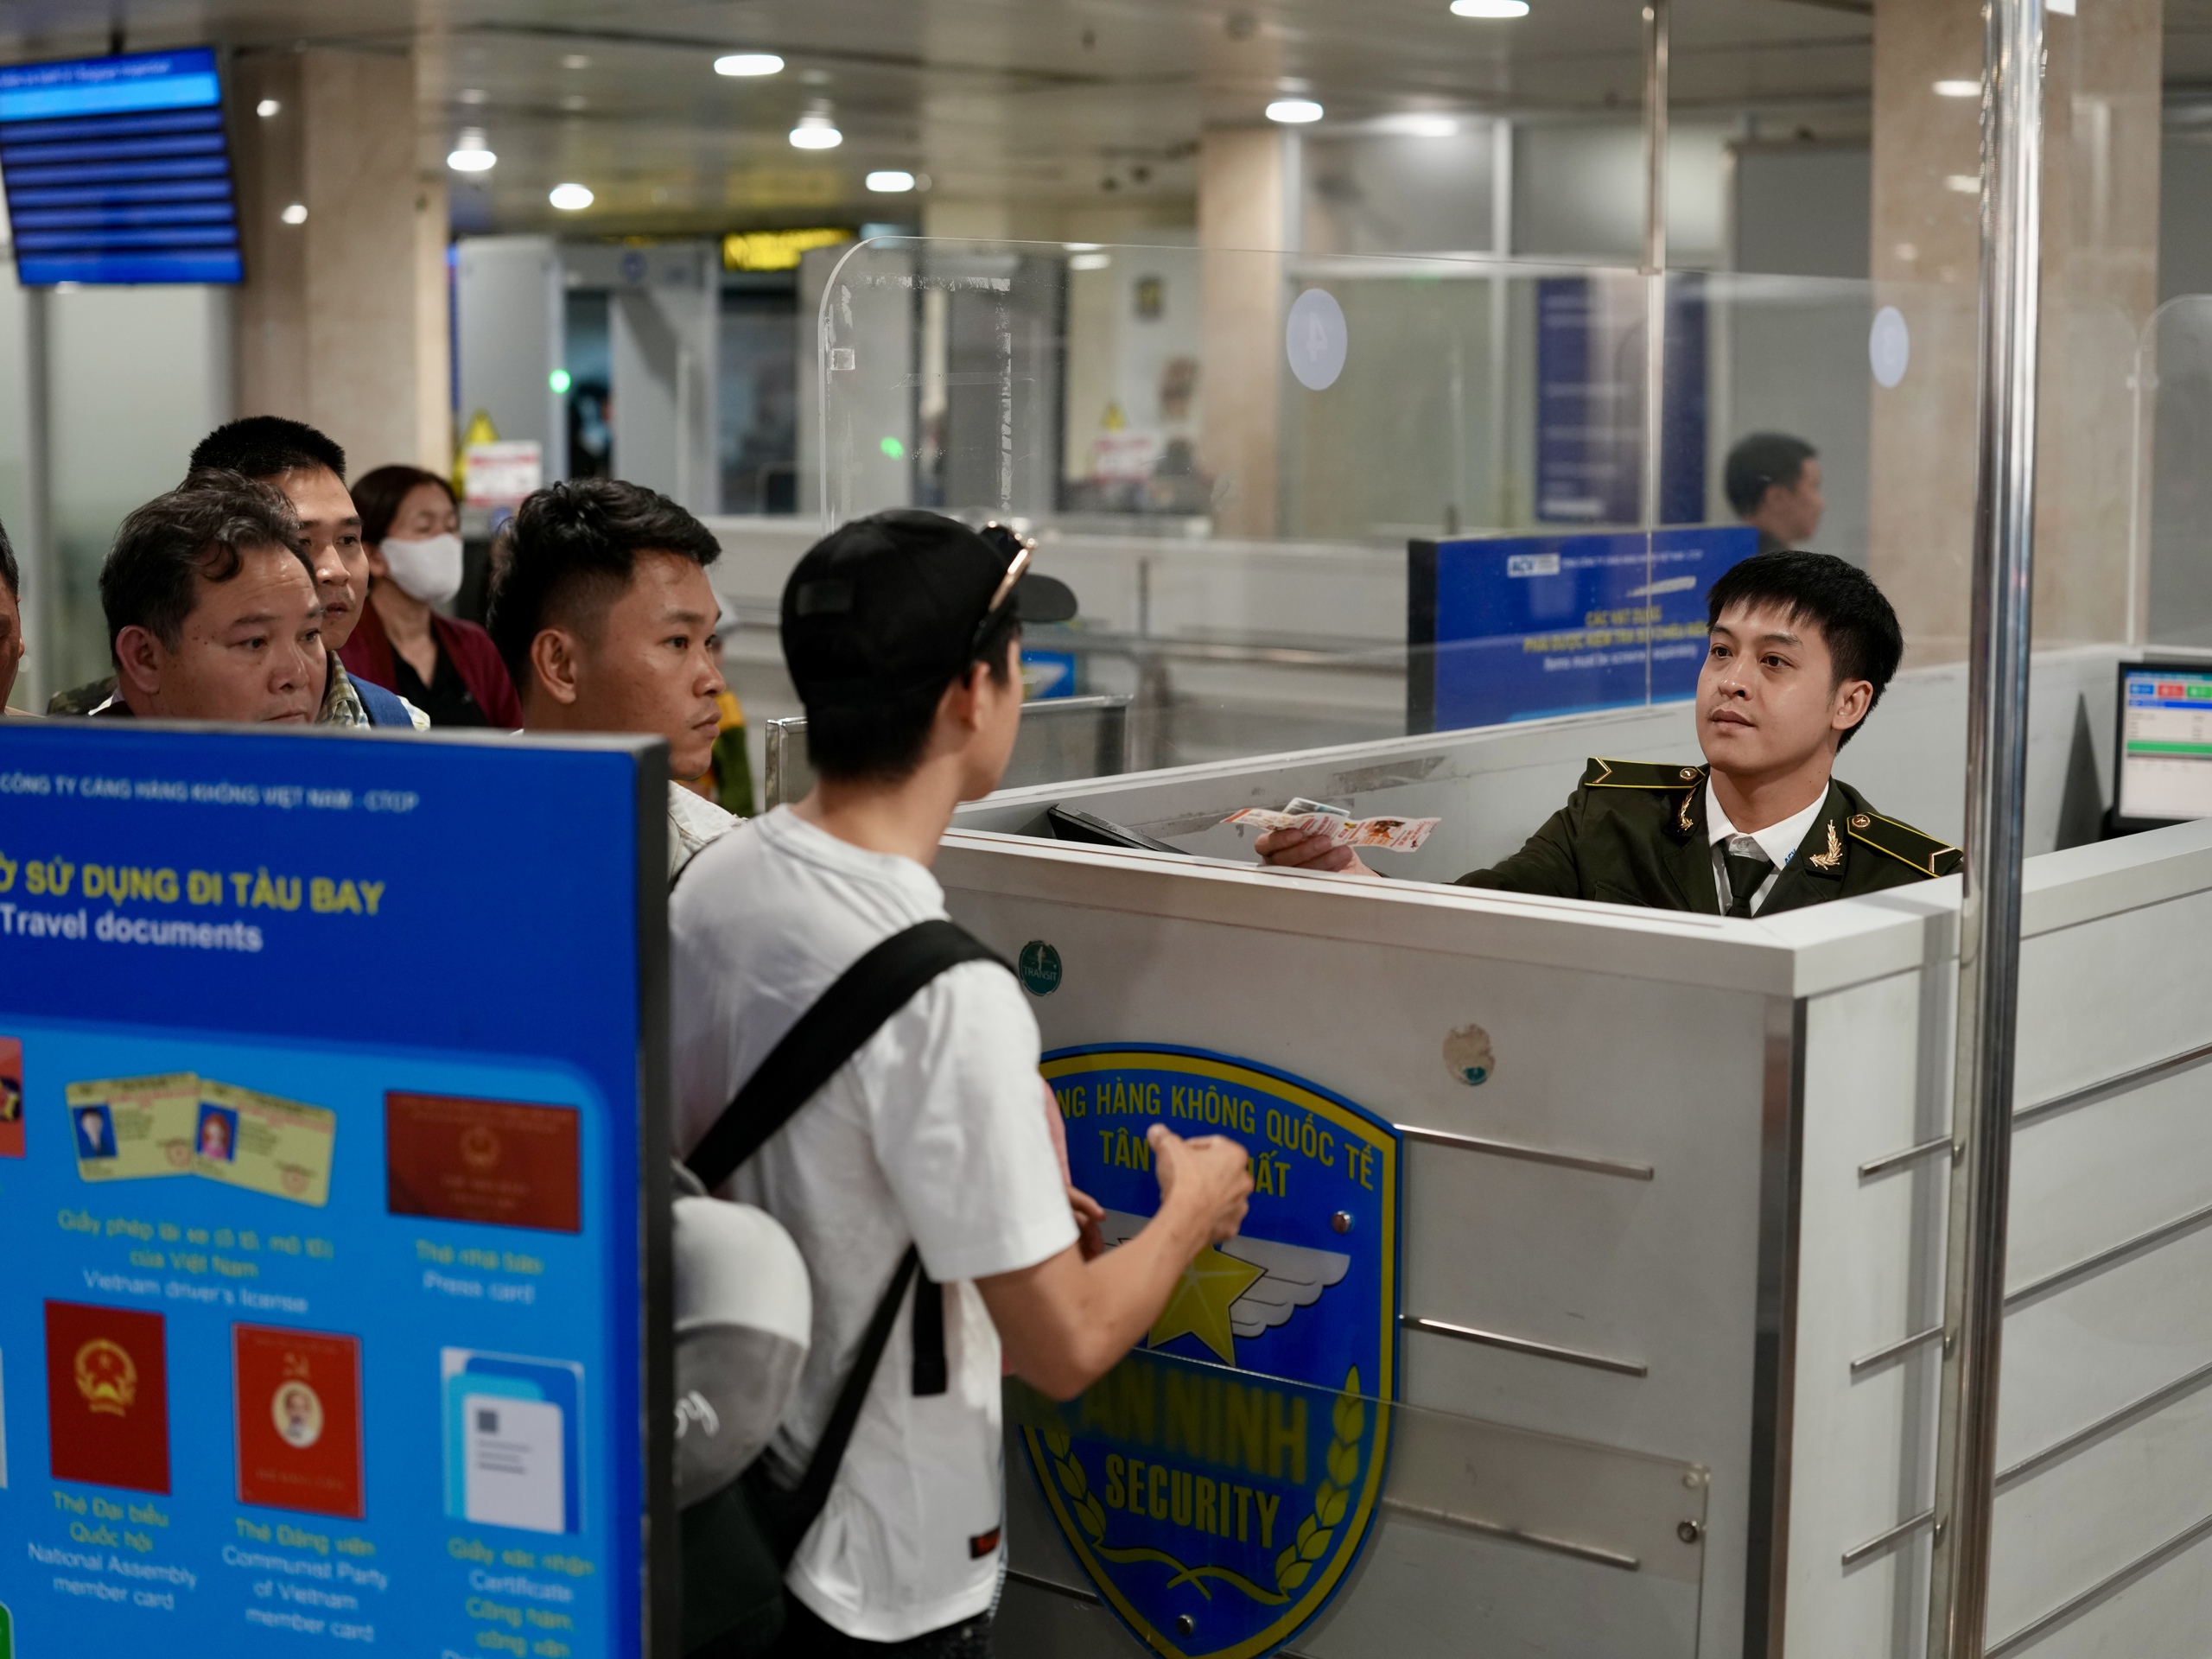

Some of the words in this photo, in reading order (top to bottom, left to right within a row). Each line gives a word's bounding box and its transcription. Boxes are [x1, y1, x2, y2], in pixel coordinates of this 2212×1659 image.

[54, 774, 77, 797] TY
[25, 855, 75, 896] SỬ
[82, 863, 180, 907] DỤNG
[187, 869, 223, 906] ĐI
[229, 866, 302, 912] TÀU
[309, 875, 385, 915] BAY
[0, 902, 87, 941] Travel
[94, 910, 264, 952] documents
[1023, 965, 1058, 981] TRANSIT
[1056, 1085, 1087, 1119] NG
[1096, 1077, 1161, 1116] HÀNG
[1171, 1085, 1255, 1135] KHÔNG
[1266, 1113, 1335, 1167] QUỐC
[1344, 1141, 1375, 1192] TẾ
[1099, 1126, 1150, 1172] TÂN
[1248, 1150, 1291, 1198] ẤT
[83, 1268, 162, 1295] Vietnam
[423, 1269, 483, 1297] Press
[487, 1281, 536, 1306] card
[1166, 1366, 1309, 1486] NINH
[1105, 1453, 1281, 1549] SECURITY
[28, 1541, 103, 1572] National
[107, 1555, 197, 1590] Assembly
[222, 1543, 332, 1580] Communist
[336, 1560, 388, 1591] Party
[469, 1567, 575, 1604] Certificate
[53, 1577, 128, 1603] member
[132, 1590, 175, 1611] card
[252, 1579, 273, 1599] of
[277, 1580, 359, 1610] Vietnam
[245, 1607, 326, 1635] member
[329, 1621, 375, 1643] card
